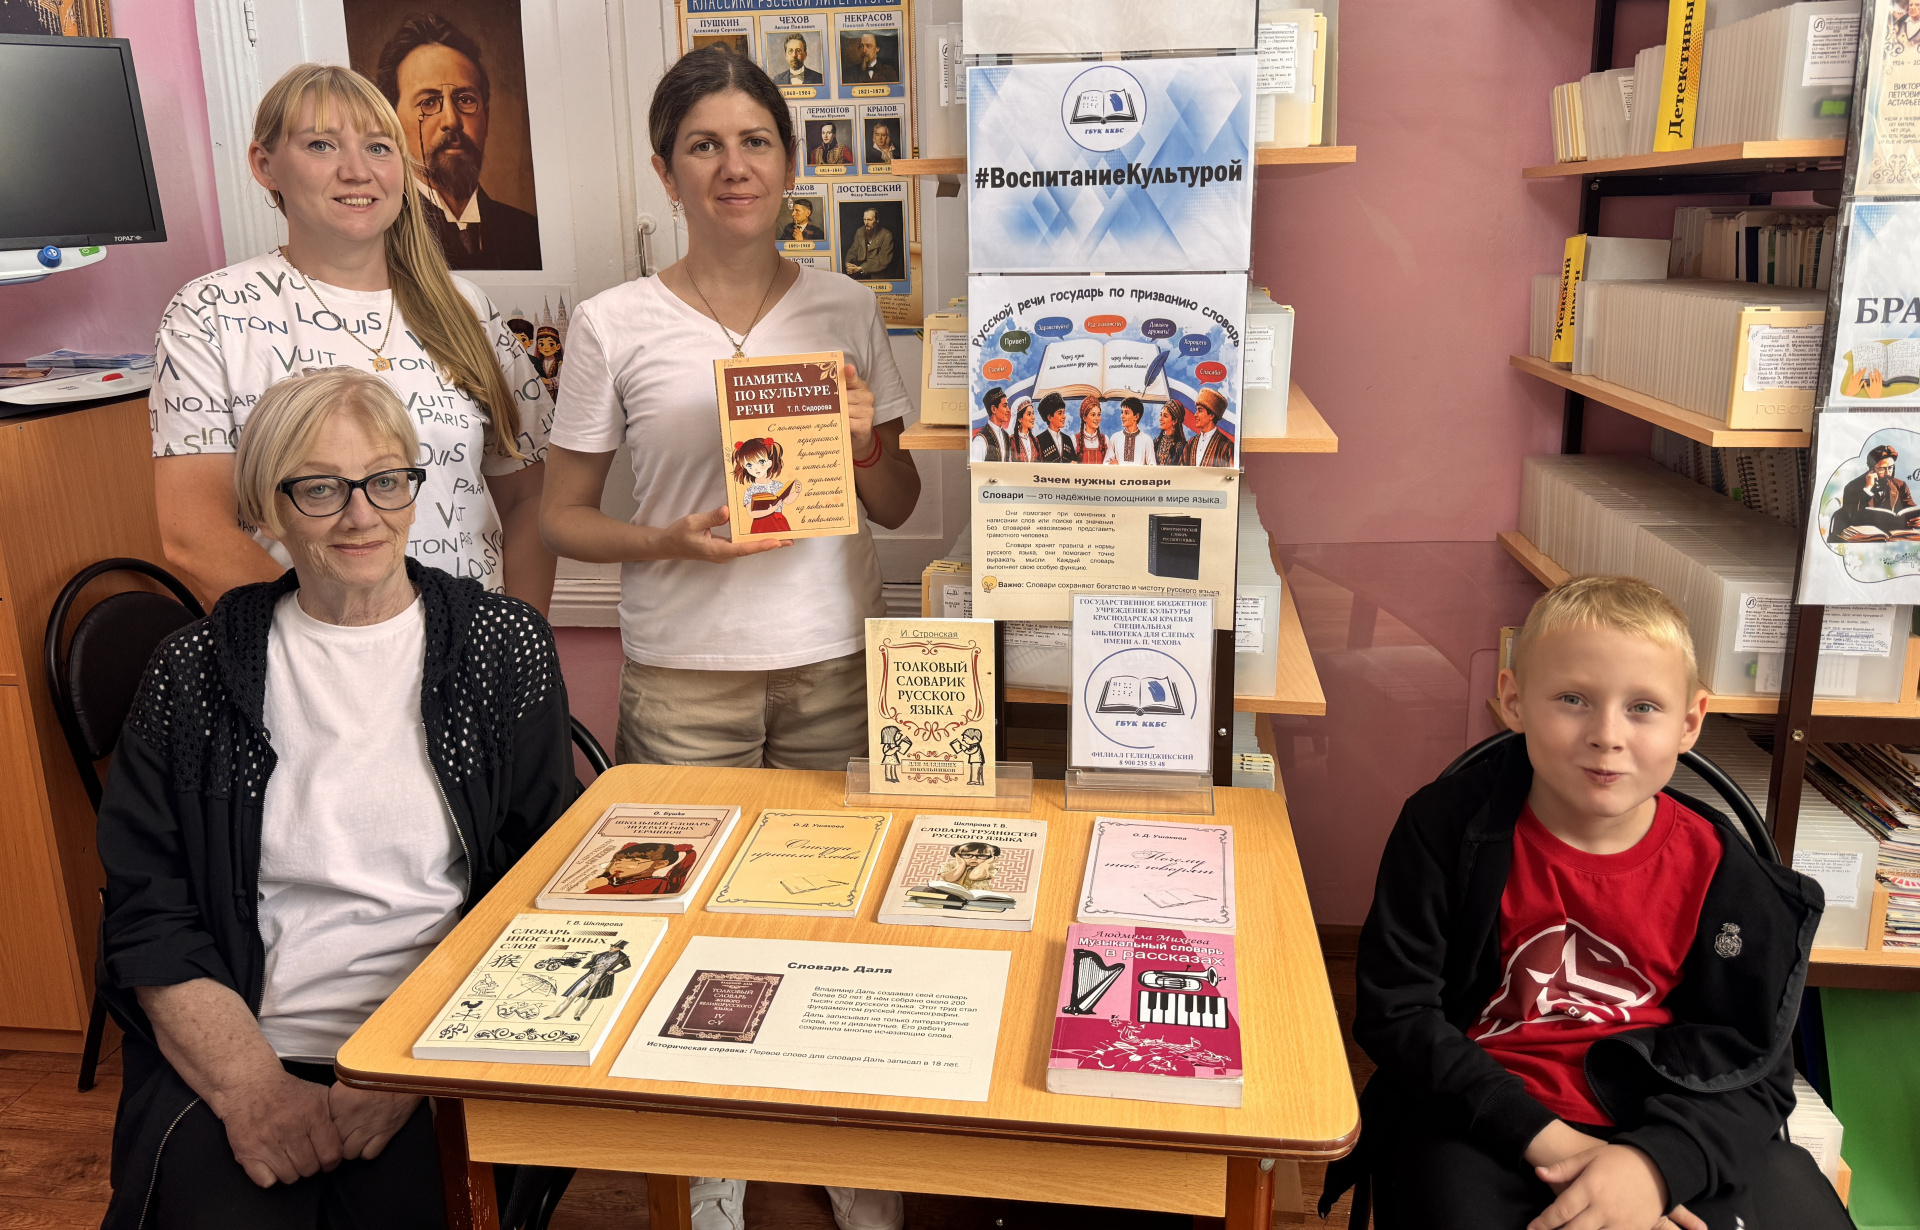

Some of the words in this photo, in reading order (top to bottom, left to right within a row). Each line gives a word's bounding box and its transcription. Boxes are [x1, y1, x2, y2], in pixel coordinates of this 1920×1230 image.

[700, 19, 739, 28] ПУШКИН
[779, 16, 809, 24] ЧЕХОВ
[844, 14, 893, 23] НЕКРАСОВ
[1668, 0, 1695, 138] Детективы
[867, 105, 897, 113] КРЫЛОВ
[974, 159, 1242, 190] #ВоспитаниеКультурой
[837, 183, 902, 194] ДОСТОЕВСКИЙ
[181, 282, 261, 316] LOUIS
[1555, 257, 1572, 341] Женский
[295, 302, 382, 335] LOUIS
[972, 302, 1014, 347] Русской
[1017, 295, 1045, 315] речи
[1050, 288, 1104, 303] государь
[1109, 288, 1125, 298] по
[1130, 289, 1198, 311] призванию
[1201, 306, 1240, 348] словарь
[1004, 337, 1027, 347] Привет!
[272, 345, 336, 373] VUIT
[1200, 368, 1223, 376] Спасибо!
[733, 372, 803, 387] ПАМЯТКА
[734, 390, 755, 402] ПО
[759, 385, 831, 400] КУЛЬТУРЕ
[736, 403, 775, 416] РЕЧИ
[787, 405, 794, 413] Т.
[802, 404, 832, 413] Сидорова
[417, 408, 469, 429] PARIS
[767, 423, 776, 432] С
[1033, 474, 1070, 484] Зачем
[1074, 478, 1116, 486] нужны
[1119, 479, 1171, 487] словари
[982, 490, 1024, 500] Словари
[1055, 492, 1101, 502] надёжные
[1103, 495, 1155, 503] помощники
[1166, 496, 1190, 504] мире
[1192, 496, 1222, 504] языка.
[998, 581, 1025, 589] Важно:
[1026, 581, 1057, 589] Словари
[1058, 583, 1095, 591] сохраняют
[1096, 583, 1131, 591] богатство
[1138, 585, 1165, 593] чистоту
[1079, 598, 1155, 606] ГОСУДАРСТВЕННОЕ
[1093, 614, 1158, 622] КРАСНОДАРСКАЯ
[900, 629, 910, 638] И.
[912, 630, 958, 639] Стронская
[893, 661, 968, 673] ТОЛКОВЫЙ
[896, 675, 966, 688] СЛОВАРИК
[898, 690, 965, 703] РУССКОГО
[909, 704, 953, 716] ЯЗЫКА
[1091, 751, 1124, 759] ФИЛИАЛ
[1125, 751, 1194, 761] ГЕЛЕНДЖИКСКИЙ
[970, 829, 1038, 838] ТРУДНОСТЕЙ
[505, 936, 608, 944] ИНОСТРАННЫХ
[1091, 930, 1152, 941] Людмила
[1155, 934, 1210, 945] Михеева
[1078, 937, 1167, 951] Музыкальный
[1170, 943, 1224, 956] словарь
[488, 953, 522, 968] 猴
[1105, 949, 1116, 957] в
[1122, 949, 1226, 967] рассказах
[787, 962, 850, 972] Словарь
[853, 965, 893, 974] Даля
[646, 1041, 707, 1051] Историческая
[709, 1046, 748, 1054] справка:
[749, 1048, 781, 1056] Первое
[827, 1054, 861, 1062] словаря
[886, 1058, 922, 1066] записал
